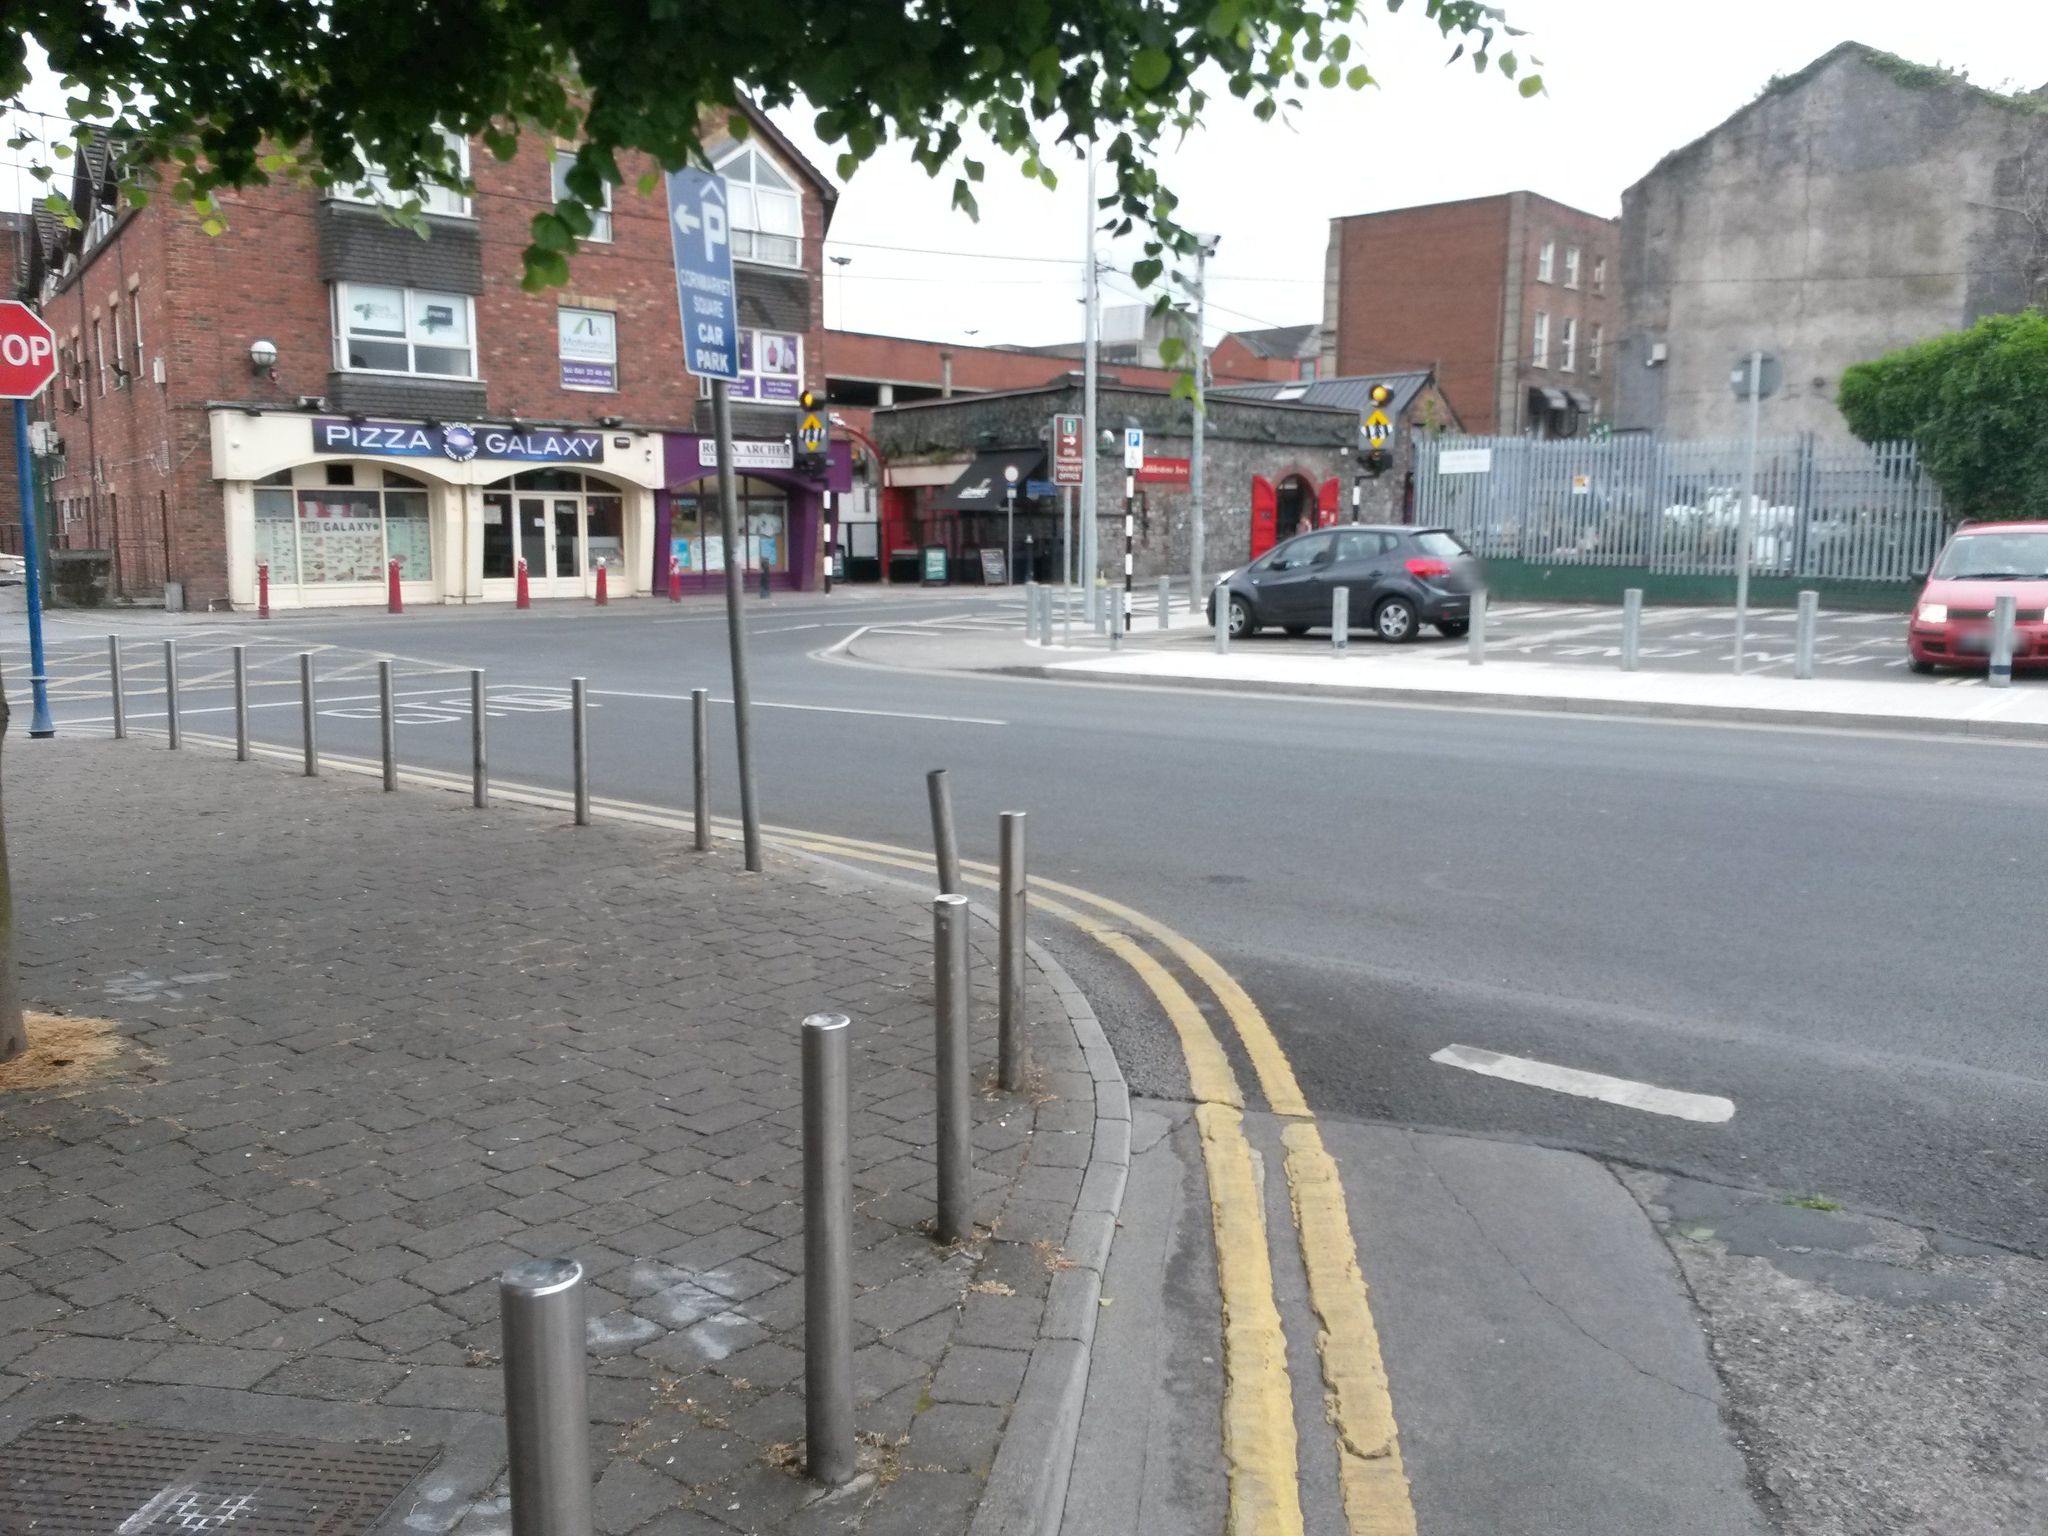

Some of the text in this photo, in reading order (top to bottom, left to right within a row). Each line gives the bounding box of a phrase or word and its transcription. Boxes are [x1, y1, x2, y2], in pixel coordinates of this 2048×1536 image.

[693, 295, 724, 319] SQUARE
[698, 322, 725, 347] CAR
[0, 334, 51, 366] OP
[696, 348, 730, 374] PARK
[326, 425, 432, 450] PIZZA
[485, 433, 599, 457] GALAXY
[745, 444, 791, 455] ARCHER
[323, 522, 373, 532] GALAXY
